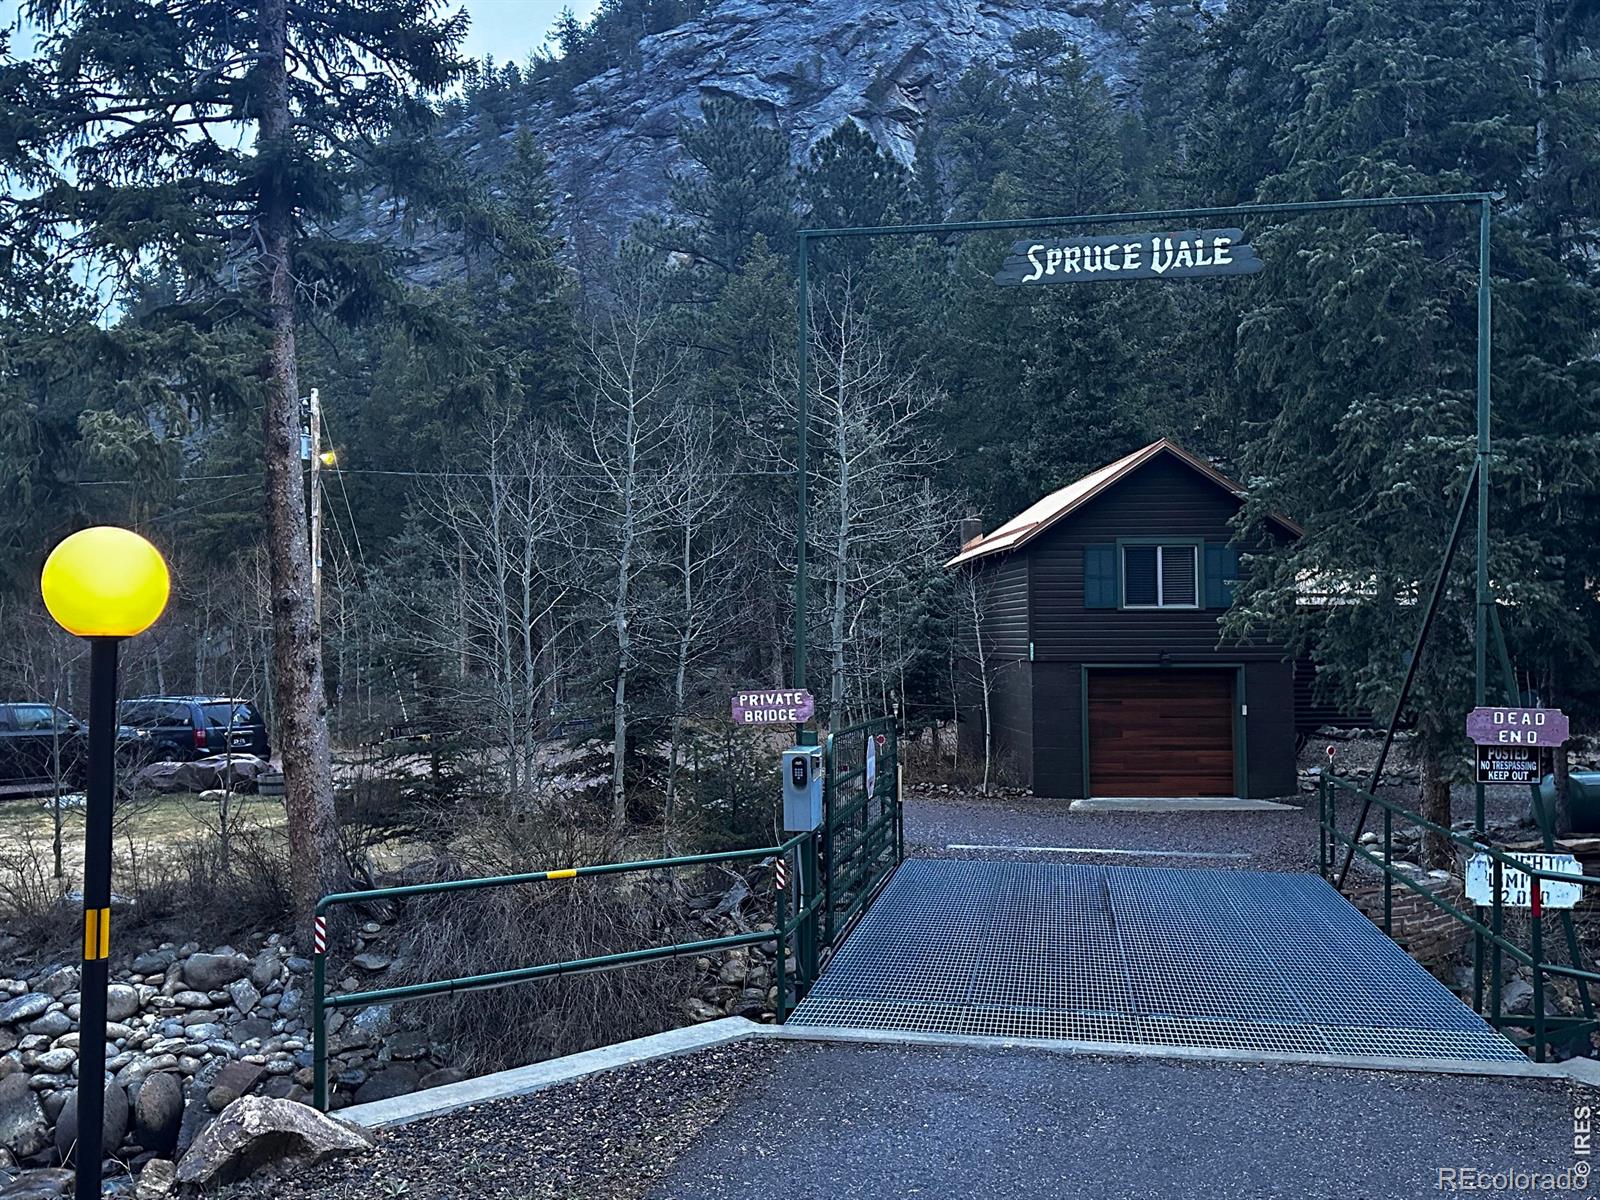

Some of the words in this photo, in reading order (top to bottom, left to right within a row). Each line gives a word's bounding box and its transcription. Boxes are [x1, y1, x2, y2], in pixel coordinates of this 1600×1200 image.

[1022, 243, 1142, 283] SPRUCE
[1150, 236, 1233, 274] VALE
[739, 692, 803, 707] PRIVATE
[744, 708, 797, 722] BRIDGE
[1493, 711, 1545, 725] DEAD
[1498, 730, 1537, 744] END
[1488, 747, 1529, 760] POSTED
[1480, 760, 1490, 770] NO
[1492, 760, 1537, 771] TRESPASSING
[1488, 770, 1509, 781] KEEP
[1511, 771, 1529, 781] OUT
[1488, 872, 1532, 888] LMI
